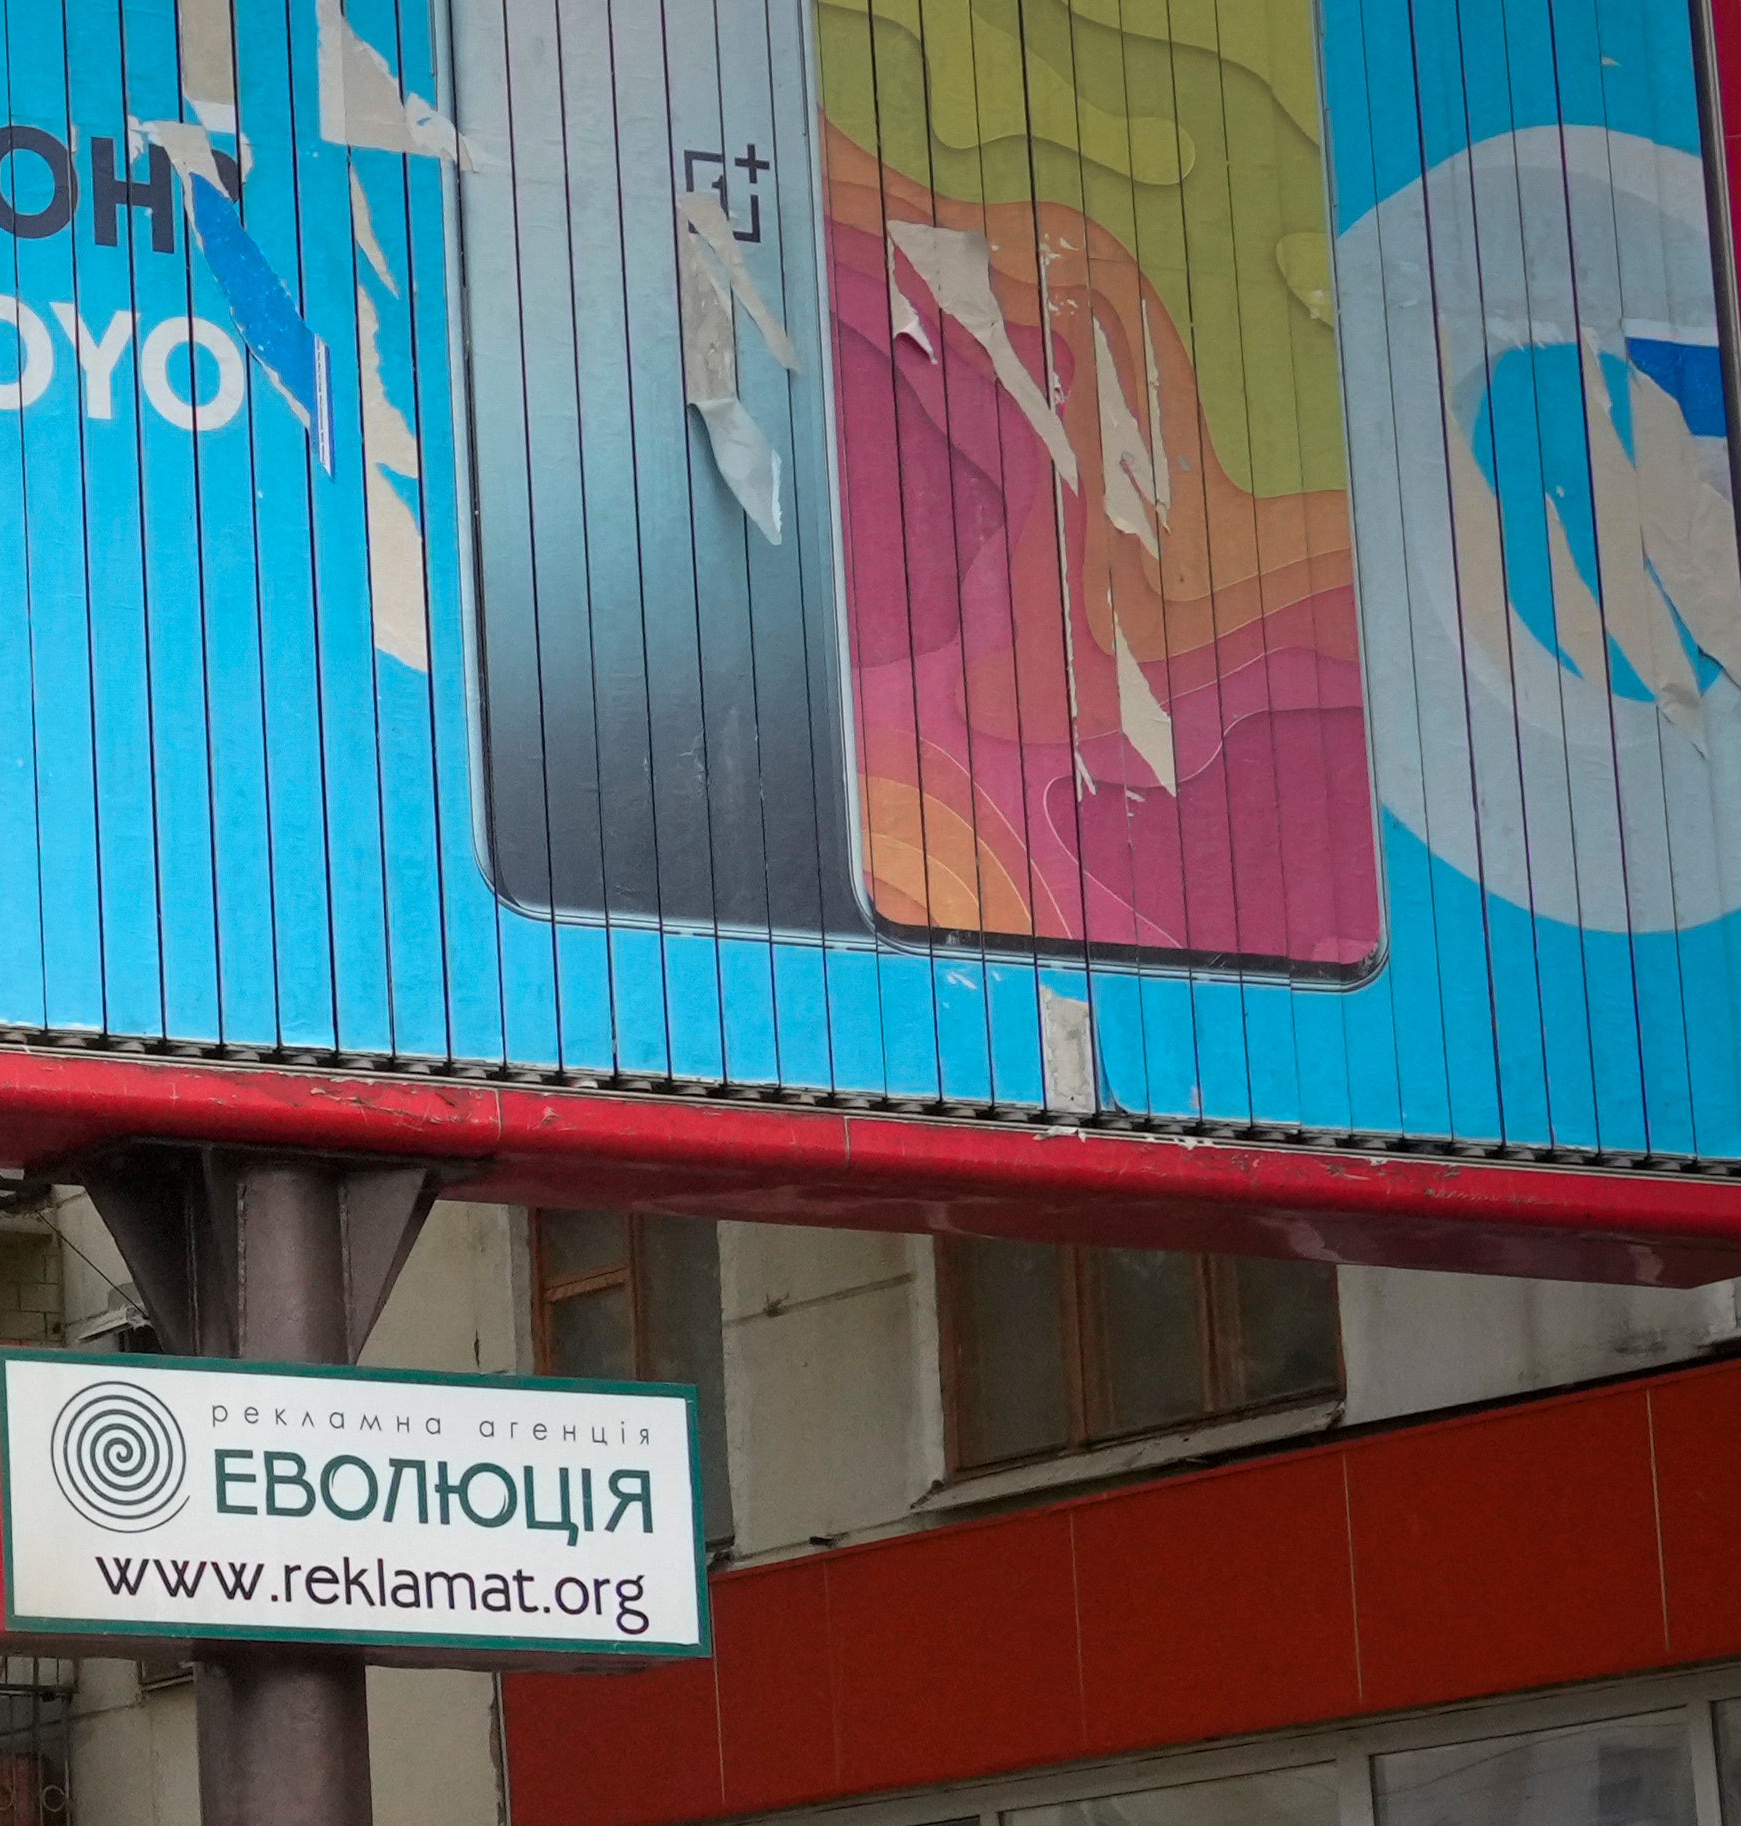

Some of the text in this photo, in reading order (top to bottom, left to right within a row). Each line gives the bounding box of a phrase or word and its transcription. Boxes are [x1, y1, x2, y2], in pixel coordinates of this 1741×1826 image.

[211, 1402, 652, 1447] рекламна агенція
[214, 1447, 654, 1547] ЕВОЛЮЦІЯ
[96, 1554, 649, 1635] www.reklamat.org
